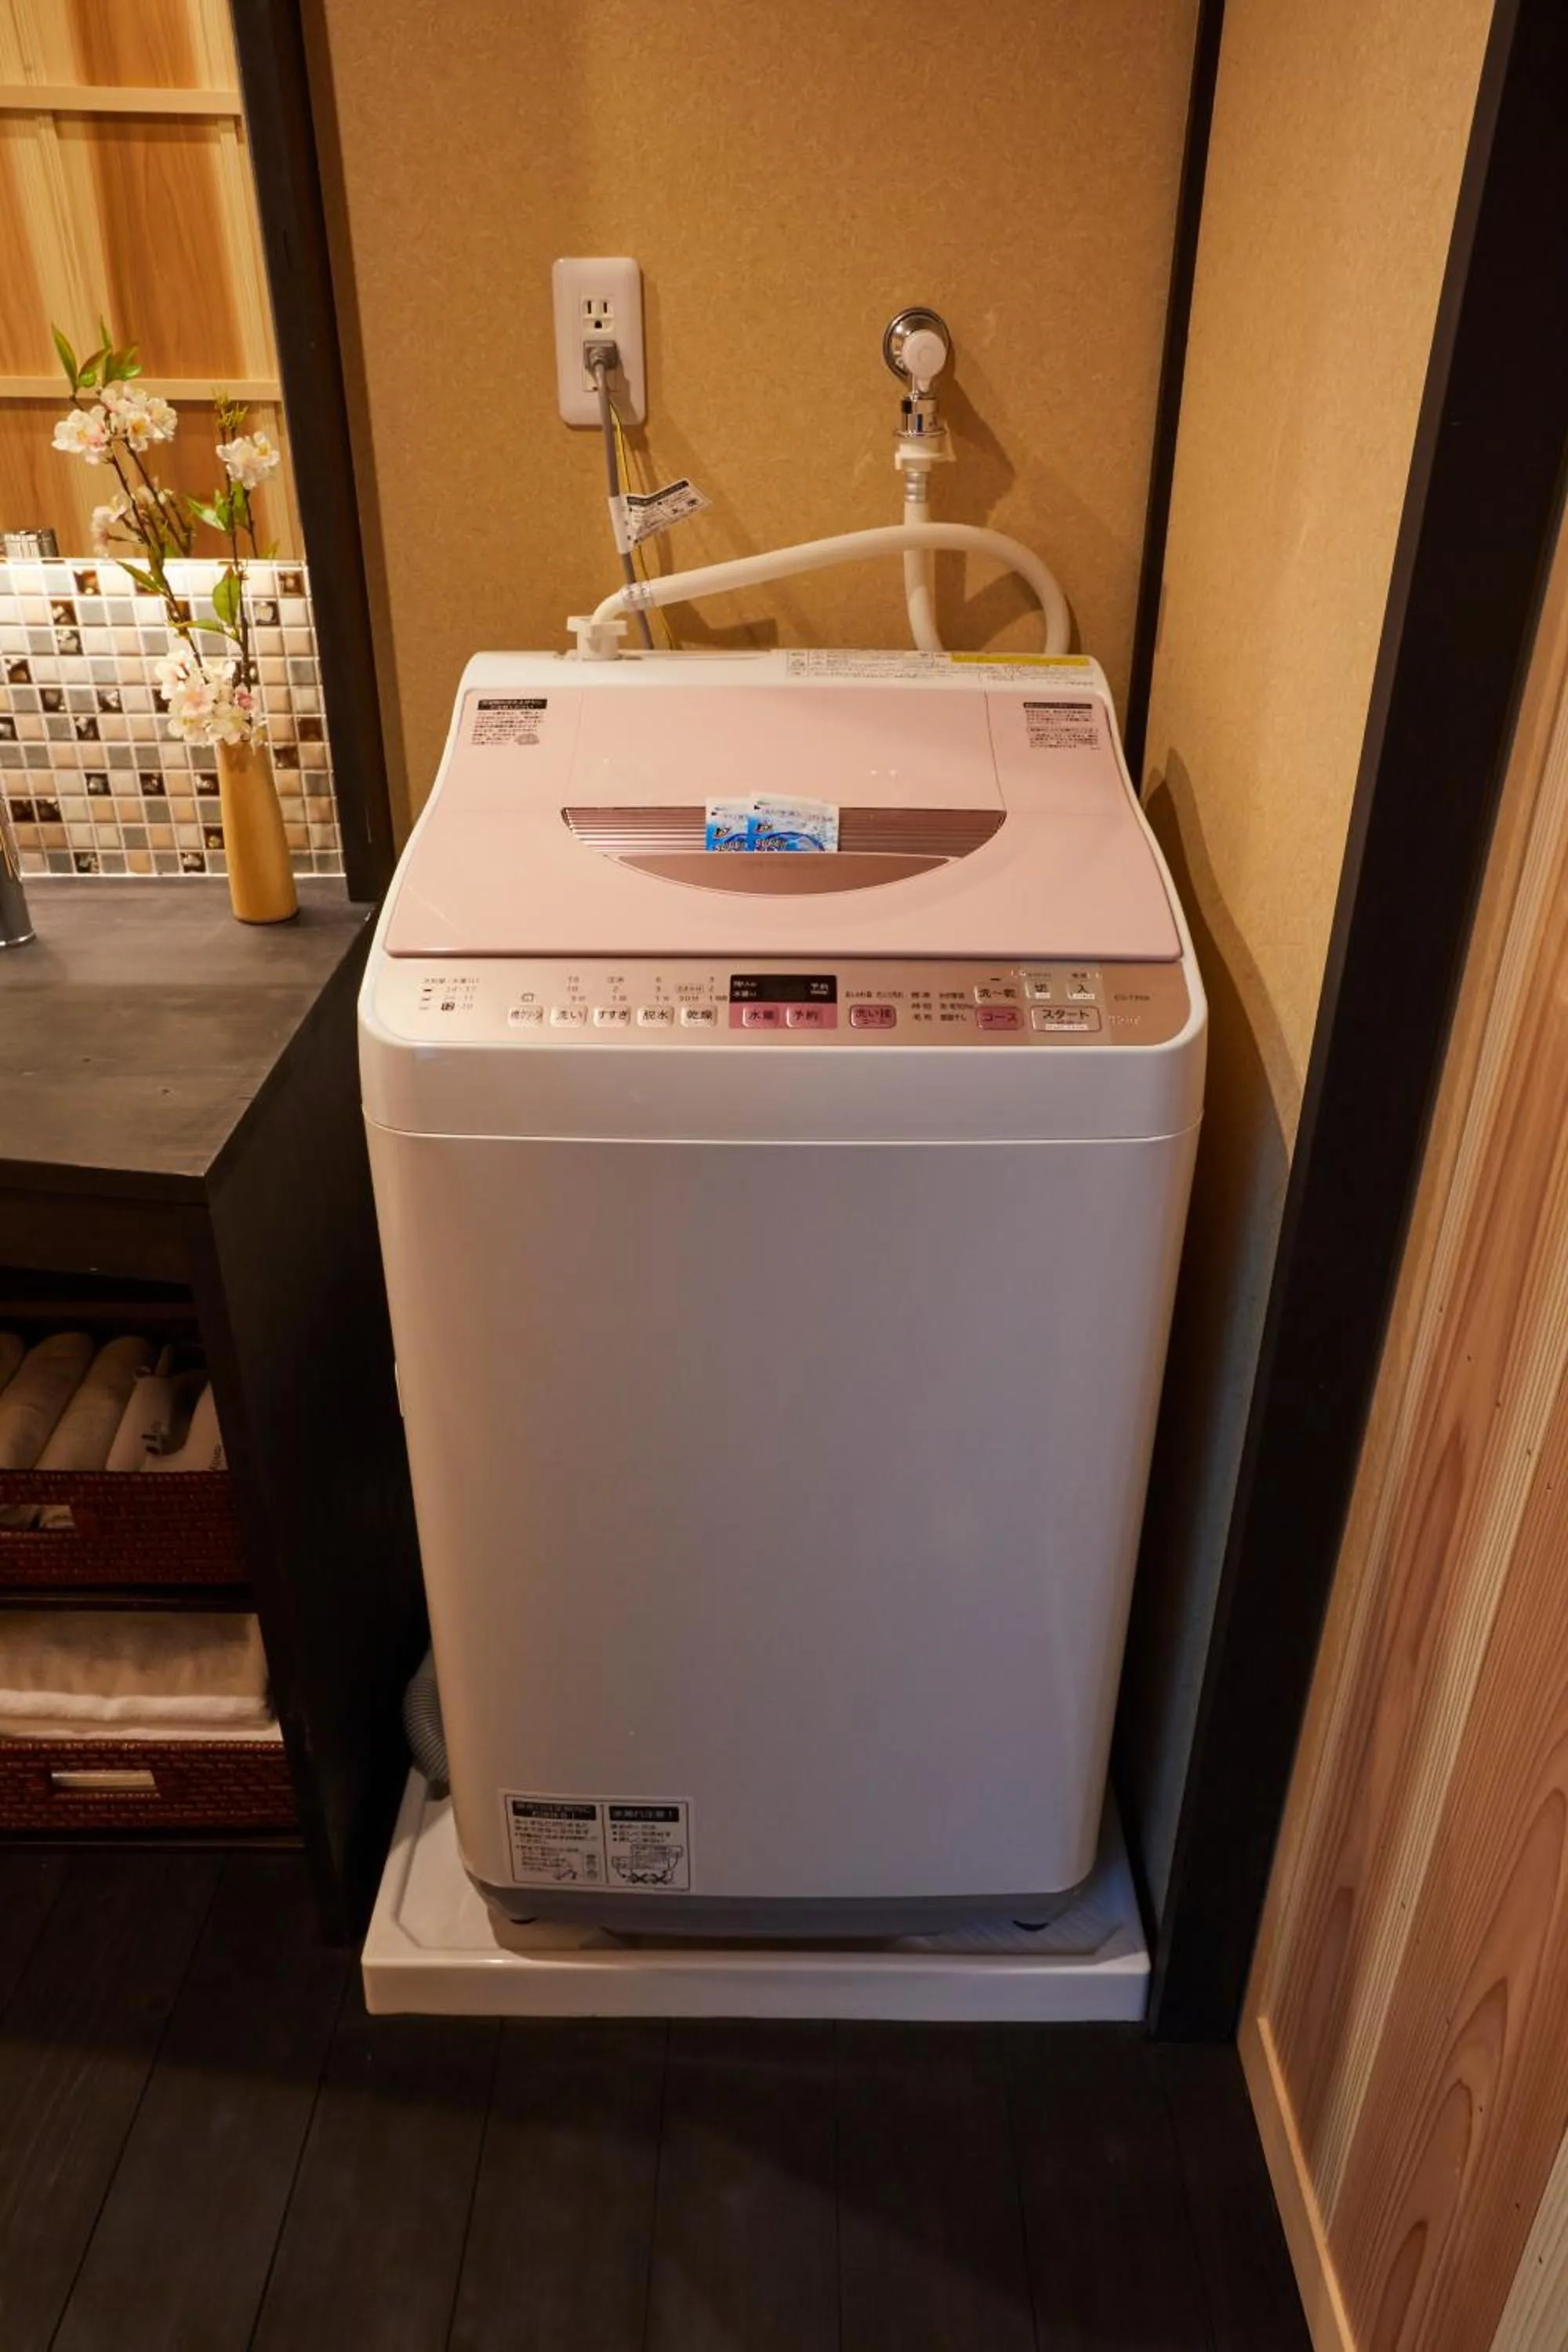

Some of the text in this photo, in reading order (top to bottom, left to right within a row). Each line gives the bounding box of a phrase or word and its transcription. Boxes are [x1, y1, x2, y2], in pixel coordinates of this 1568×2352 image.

[1077, 983, 1089, 993] 入
[557, 1009, 583, 1020] 洗い
[598, 1009, 629, 1020] すすぎ
[642, 1009, 669, 1020] 脱水
[686, 1009, 713, 1020] 乾燥
[794, 1010, 818, 1022] 予約
[982, 1011, 1018, 1022] コース
[1042, 1009, 1090, 1020] スタート
